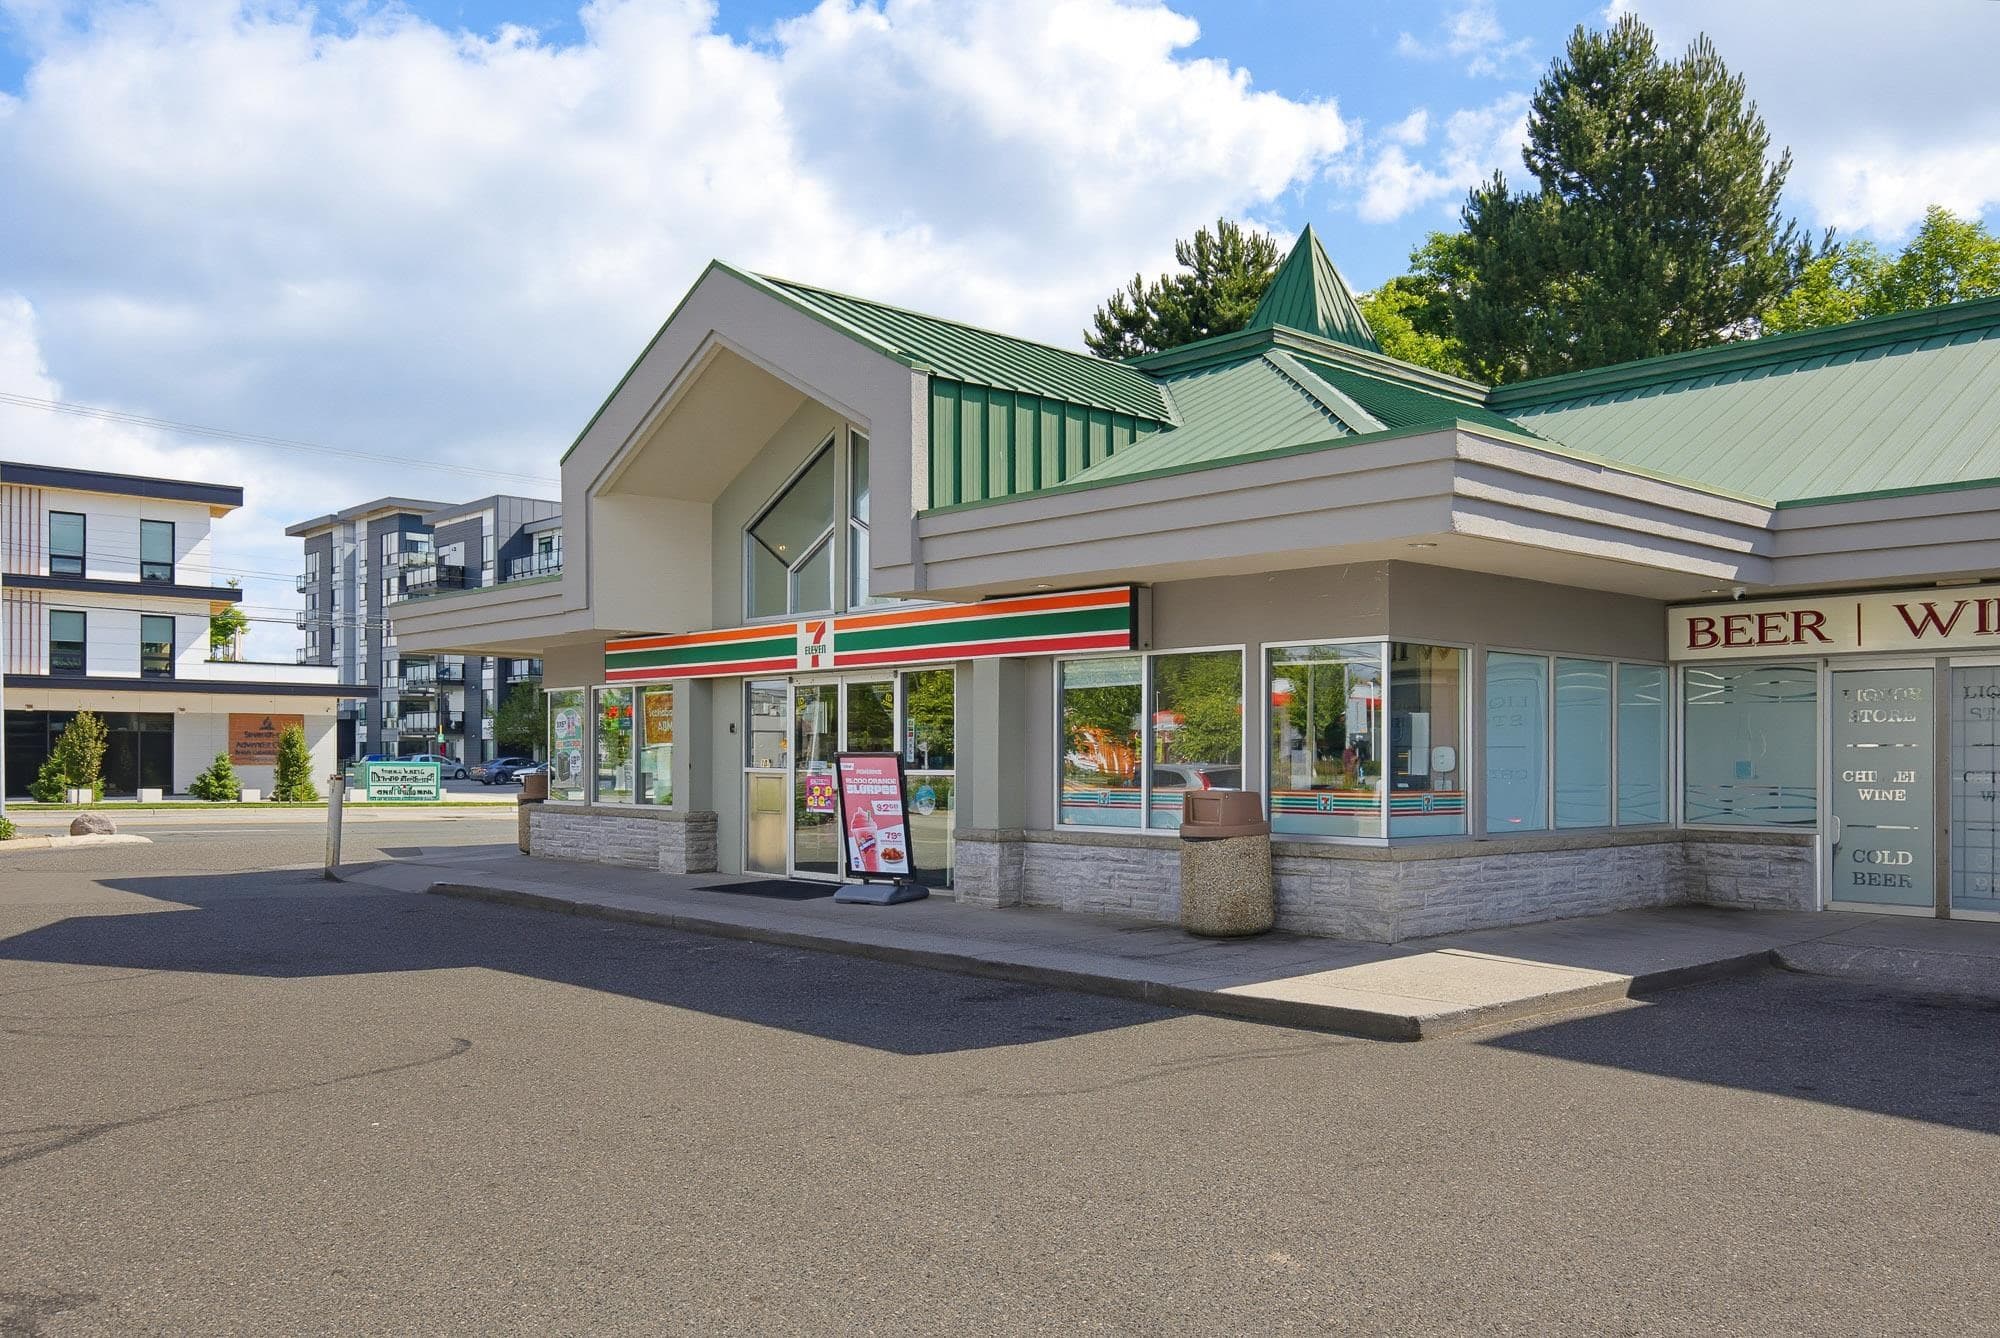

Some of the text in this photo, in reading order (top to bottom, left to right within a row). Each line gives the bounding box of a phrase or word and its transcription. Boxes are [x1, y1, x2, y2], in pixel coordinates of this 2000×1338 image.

[1687, 598, 2000, 650] BEER WI
[805, 621, 826, 668] 7
[1858, 788, 1906, 801] WINE
[1852, 849, 1913, 865] COLD
[1852, 871, 1913, 889] BEER
